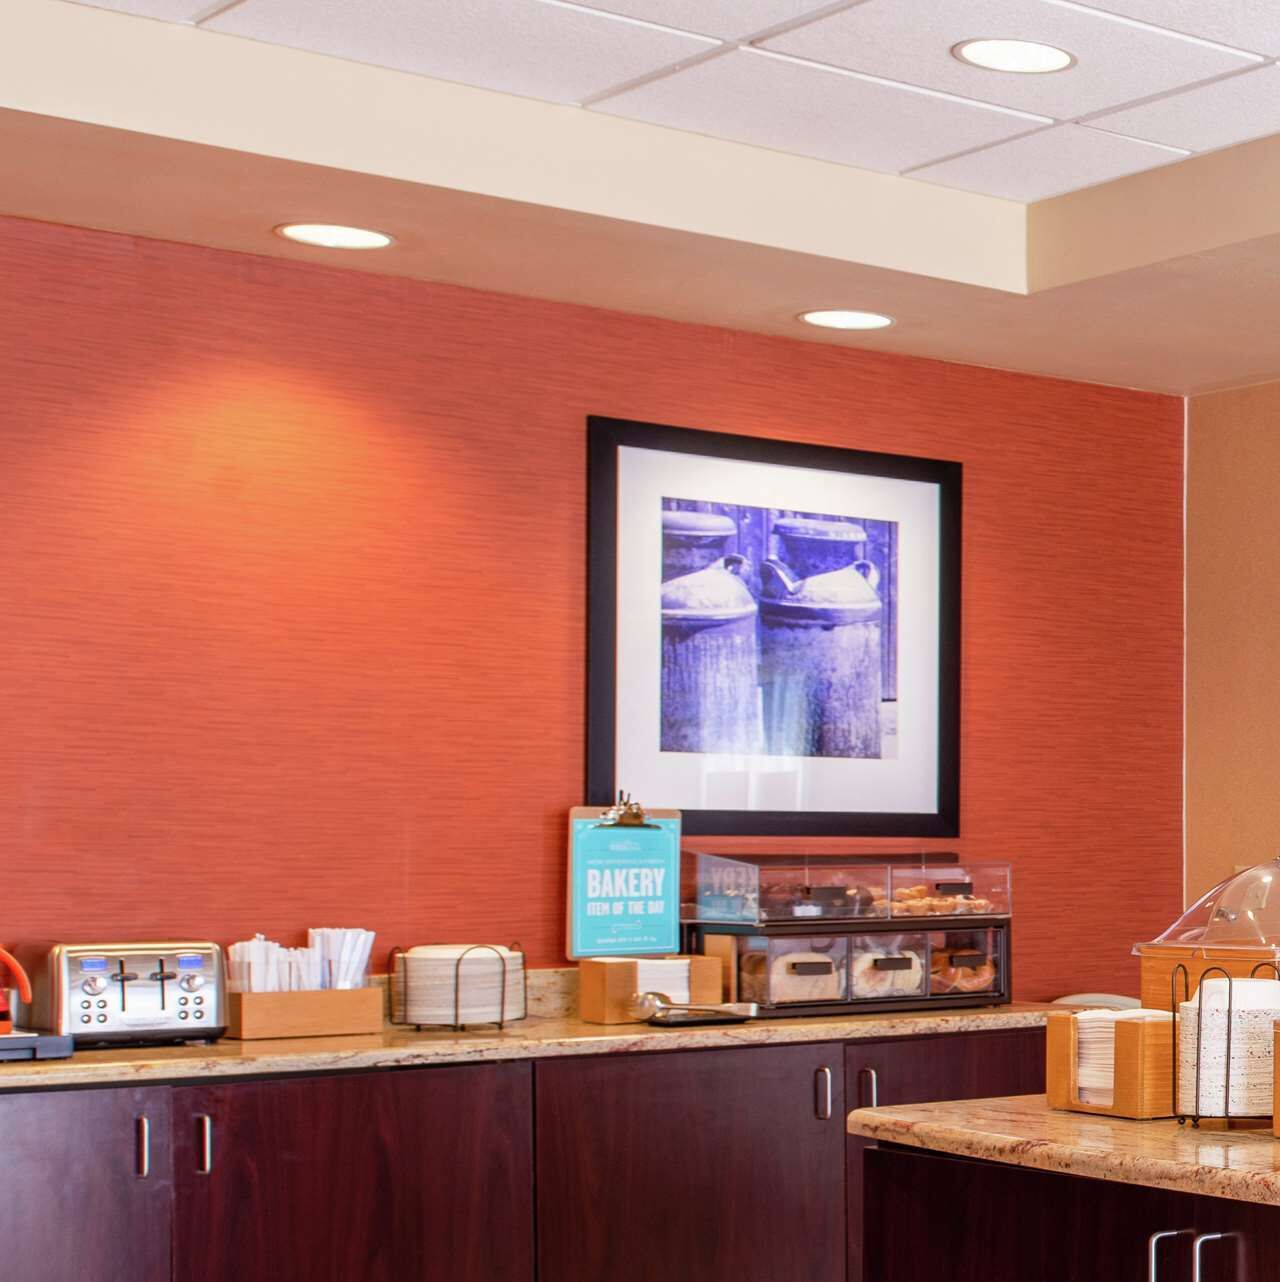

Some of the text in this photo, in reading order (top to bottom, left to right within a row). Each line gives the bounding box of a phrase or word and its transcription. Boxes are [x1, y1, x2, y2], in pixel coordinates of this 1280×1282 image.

[586, 867, 666, 899] BAKERY
[586, 900, 665, 917] ITEM OF THE DAY
